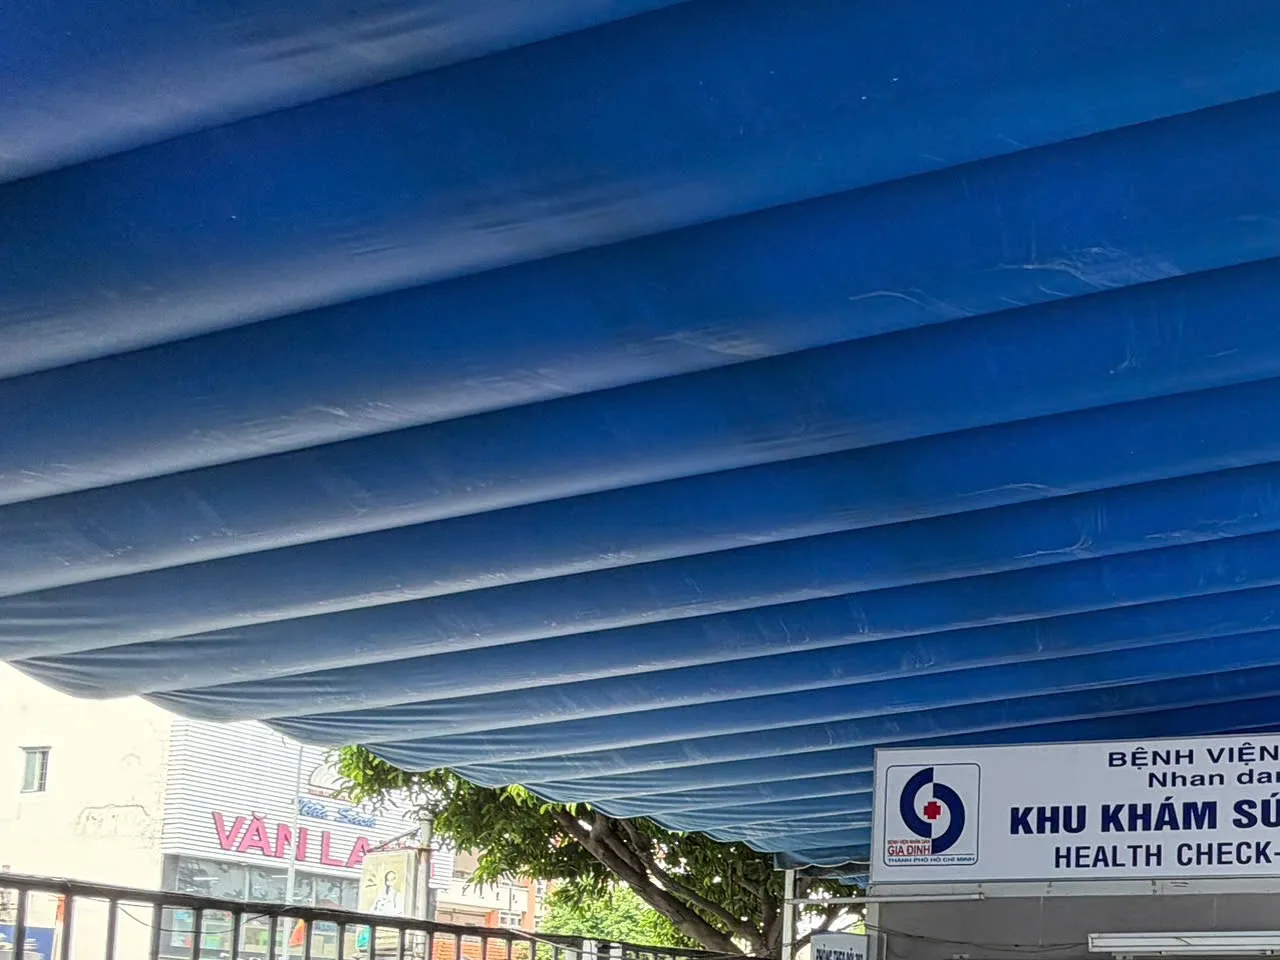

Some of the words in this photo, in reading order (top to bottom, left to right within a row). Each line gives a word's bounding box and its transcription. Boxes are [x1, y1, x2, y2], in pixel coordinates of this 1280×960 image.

[1108, 746, 1194, 770] BỆNH
[1206, 741, 1279, 766] VIỆN
[1148, 771, 1225, 788] Nhan
[1010, 804, 1087, 835] KHU
[1100, 795, 1218, 833] KHÁM
[212, 811, 309, 862] VĂN
[887, 845, 904, 855] GIA
[1054, 844, 1162, 869] HEALTH
